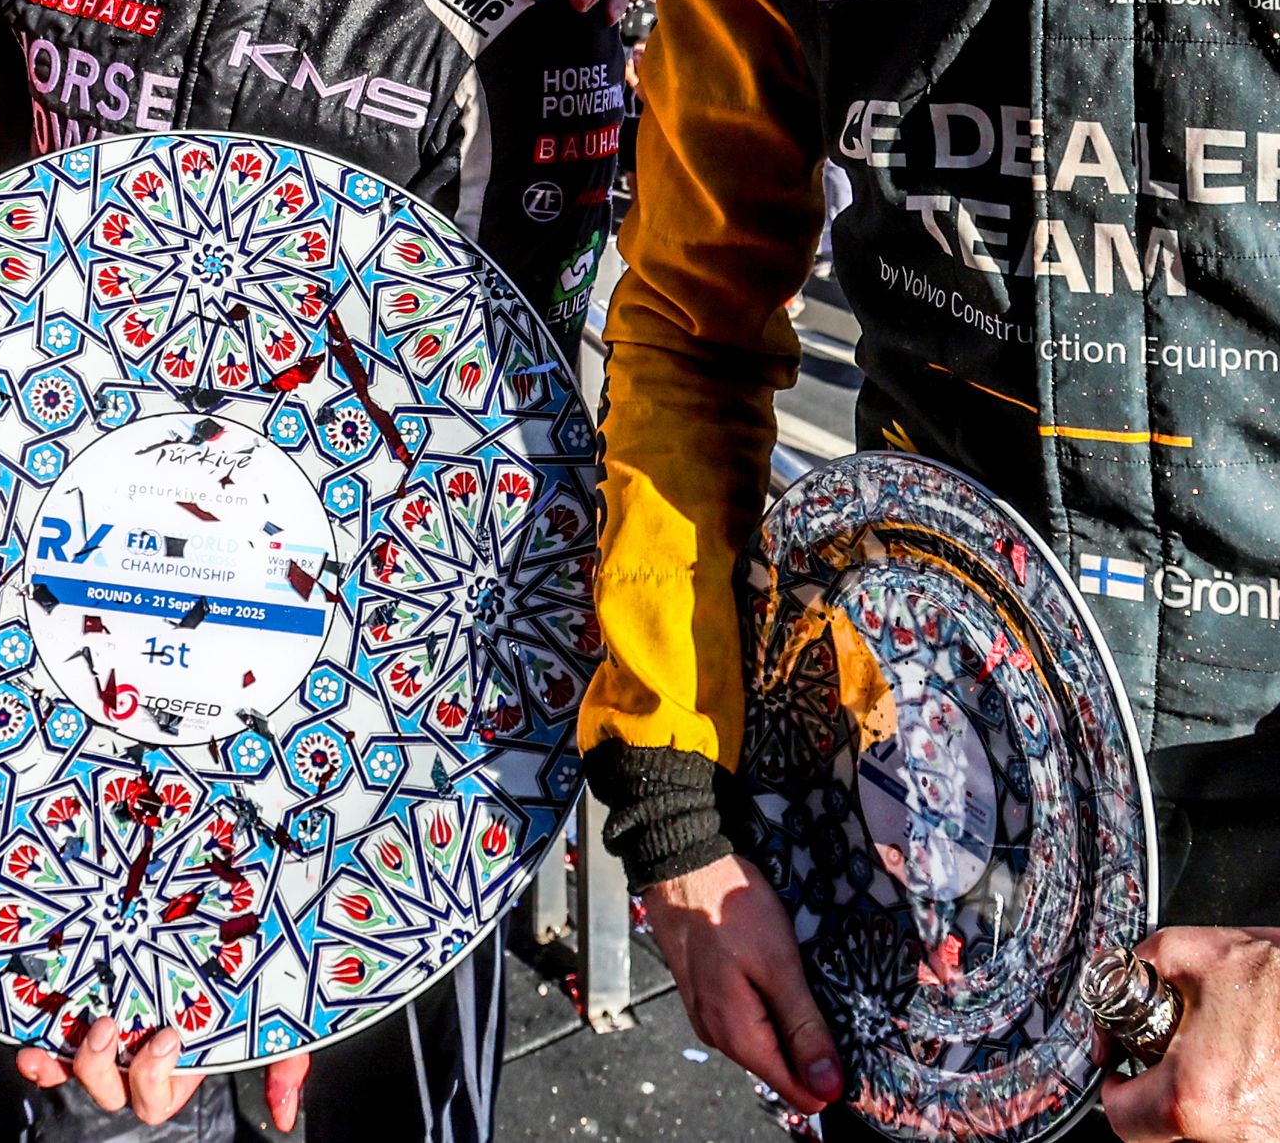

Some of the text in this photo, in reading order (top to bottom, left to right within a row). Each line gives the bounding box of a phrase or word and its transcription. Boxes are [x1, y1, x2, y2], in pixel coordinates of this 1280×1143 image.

[22, 32, 181, 132] ORSE
[228, 30, 432, 130] KMS
[543, 63, 609, 93] HORSE
[839, 99, 907, 168] CE
[905, 194, 1189, 298] TEAM
[878, 256, 900, 286] by
[900, 267, 947, 309] Volvo
[951, 290, 1128, 366] Construction
[128, 483, 249, 507] goturkiye.com
[37, 516, 115, 564] RX
[120, 557, 237, 584] CHAMPIONSHIP
[301, 558, 315, 570] RX
[86, 586, 132, 604] ROUND
[133, 593, 143, 606] 6
[152, 595, 166, 608] 21
[167, 597, 234, 618] Septber
[235, 604, 266, 621] 2025
[145, 636, 191, 669] 1st
[144, 695, 222, 717] TOSFED
